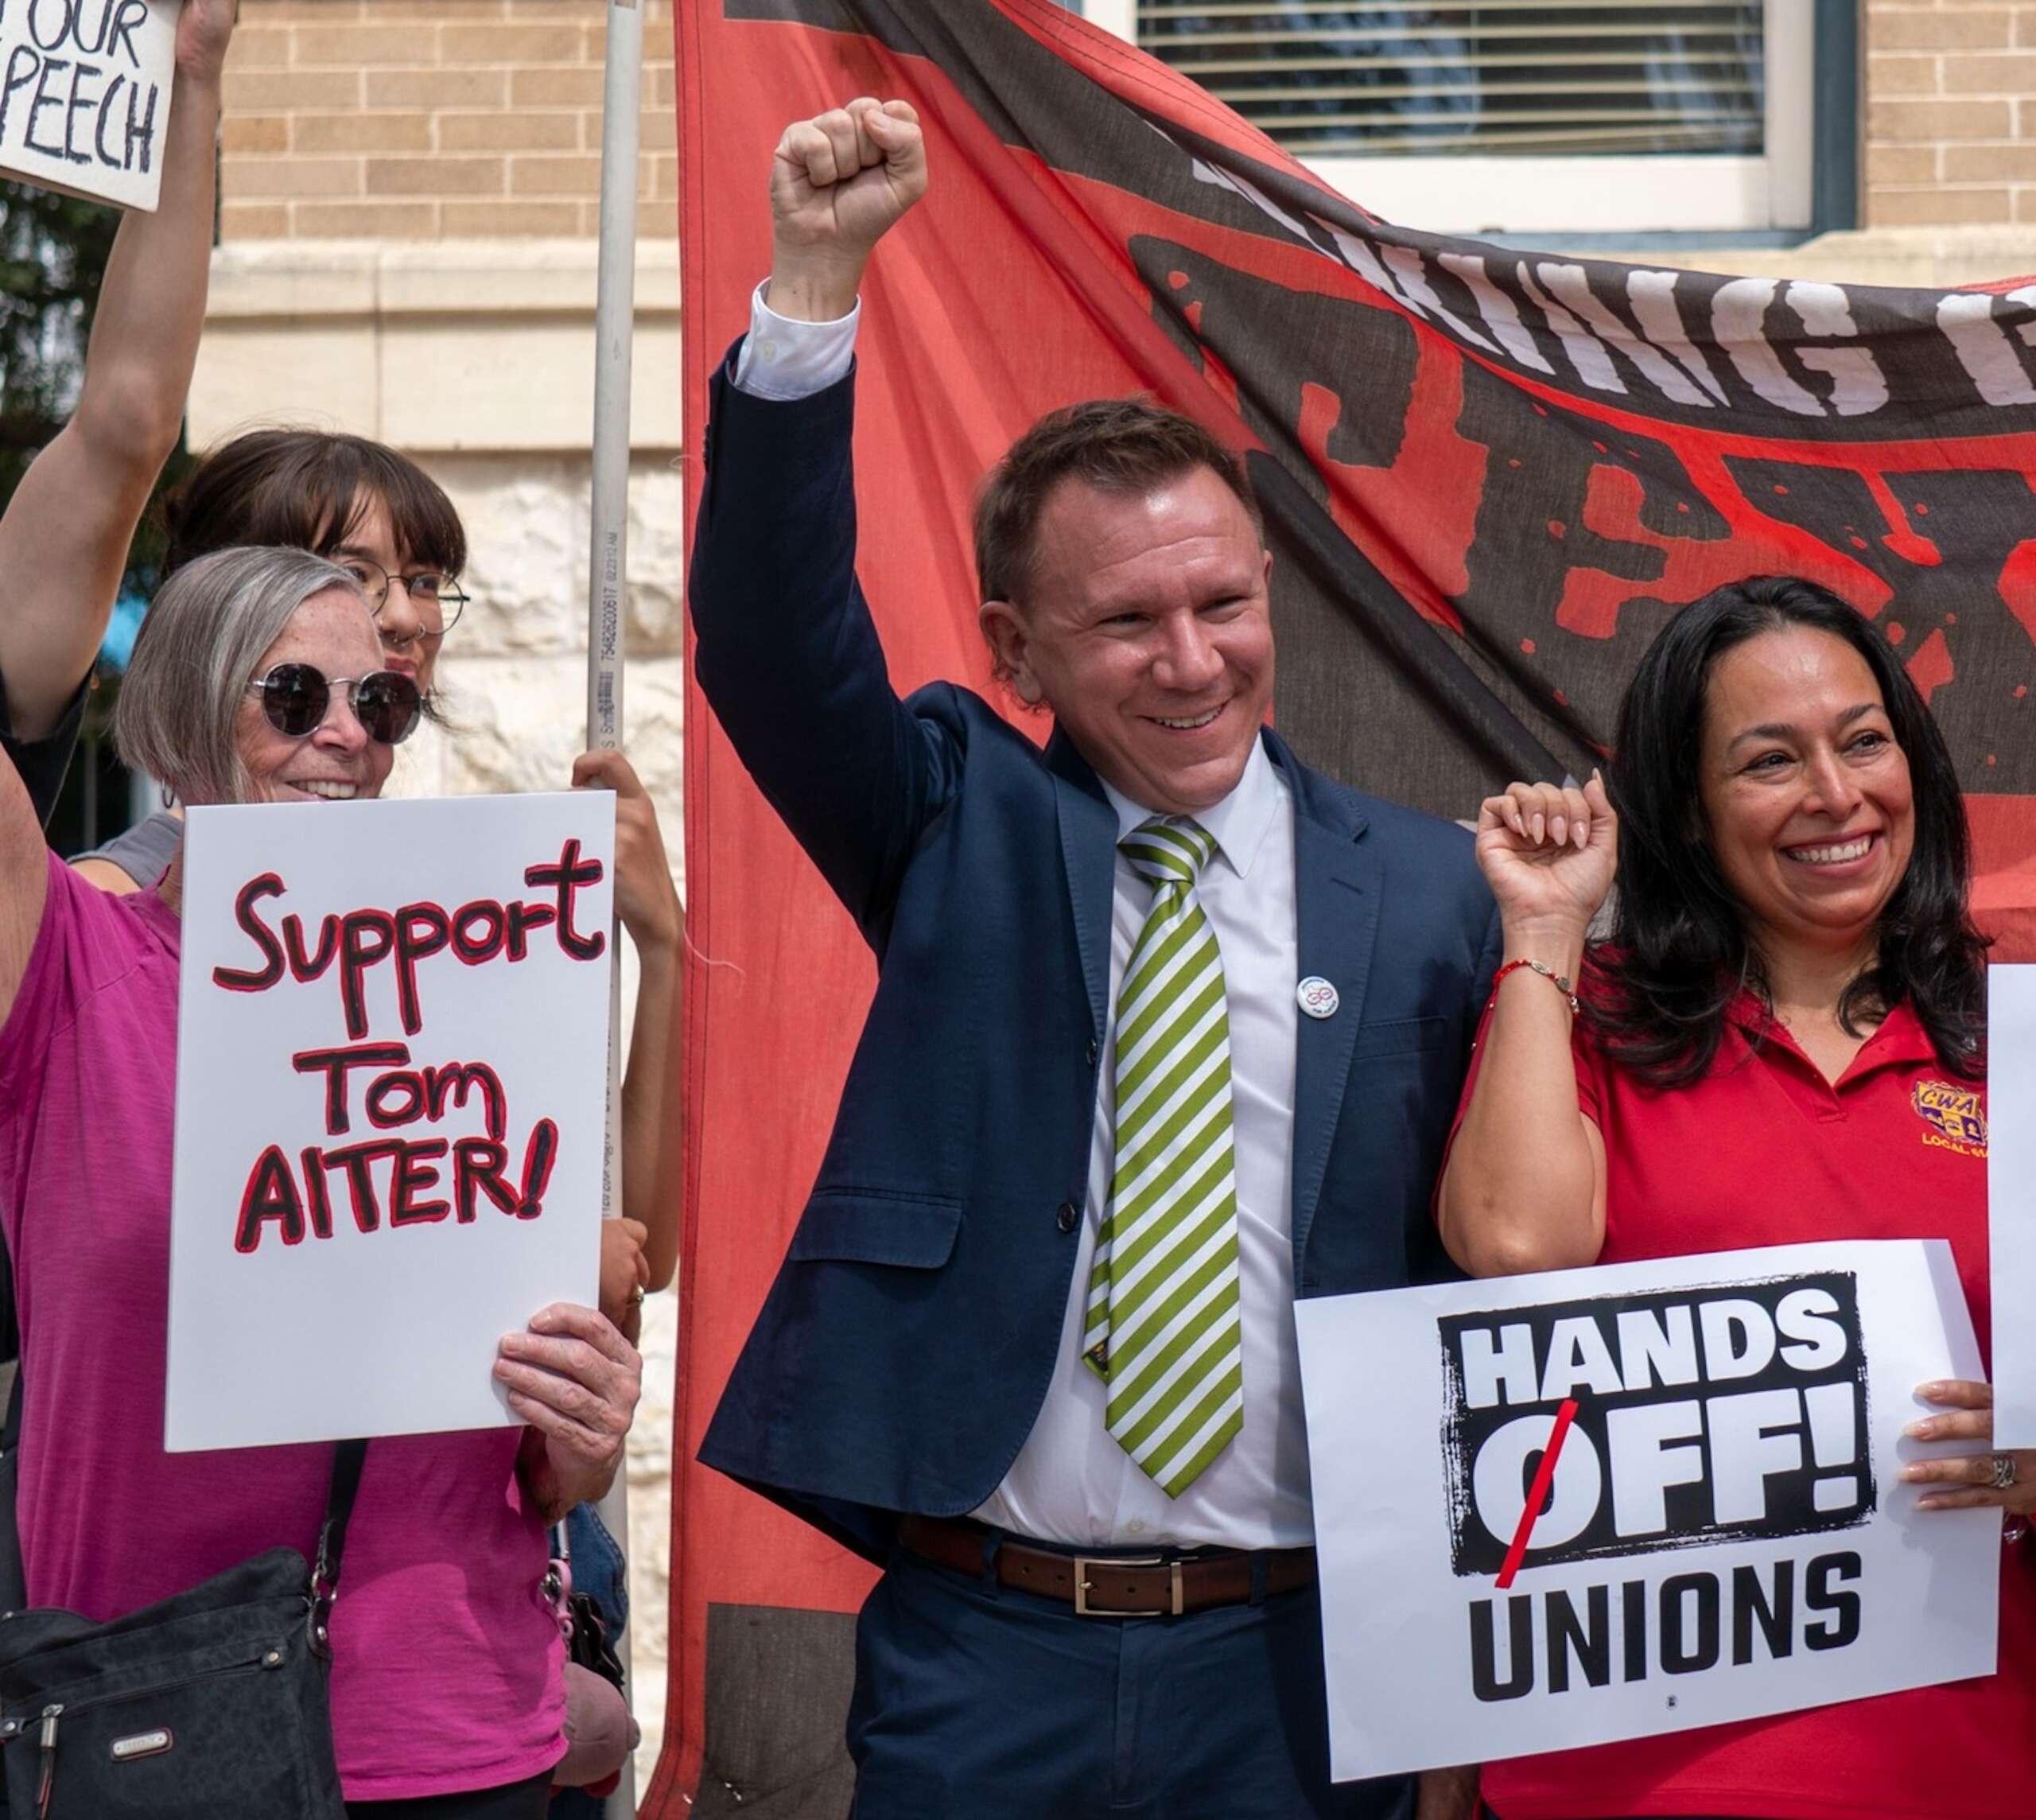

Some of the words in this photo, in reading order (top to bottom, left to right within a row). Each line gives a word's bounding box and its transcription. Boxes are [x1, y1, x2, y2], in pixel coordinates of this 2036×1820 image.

[0, 0, 148, 68] OUR
[212, 838, 605, 1040] Support
[293, 1042, 507, 1142] Tom
[1921, 1089, 1974, 1114] CWA
[1921, 1132, 1971, 1156] LOCAL
[1459, 1288, 1847, 1410] HANDS
[1472, 1380, 1860, 1552] OFF!
[1468, 1550, 1862, 1702] UNIONS
